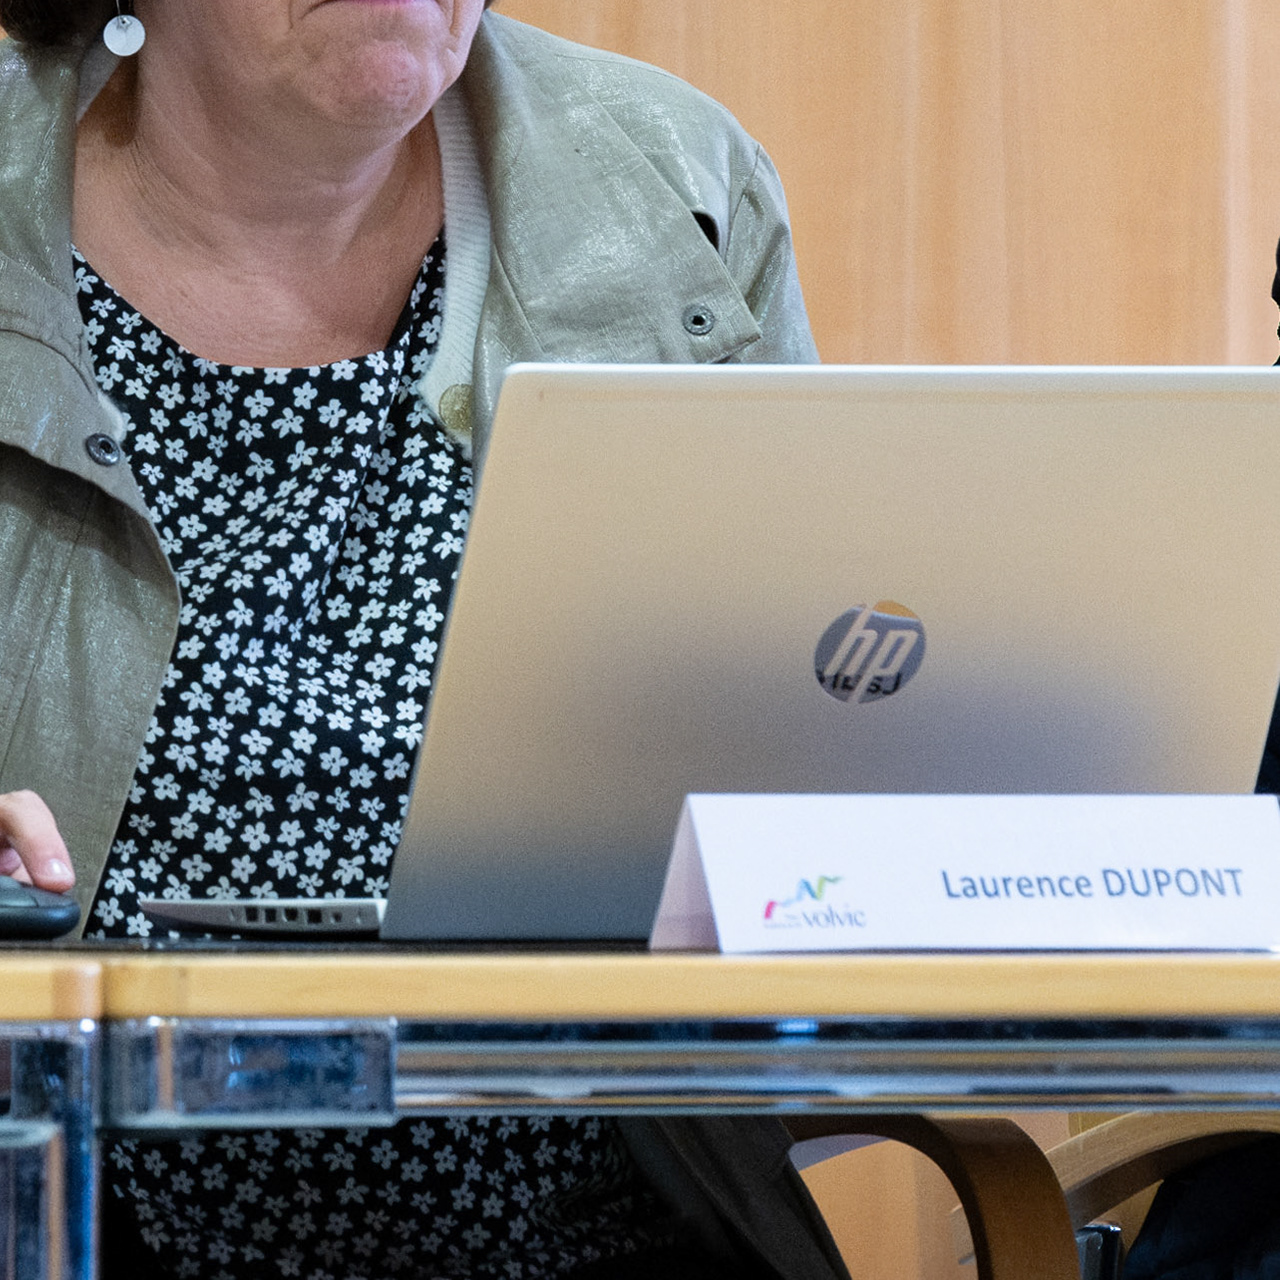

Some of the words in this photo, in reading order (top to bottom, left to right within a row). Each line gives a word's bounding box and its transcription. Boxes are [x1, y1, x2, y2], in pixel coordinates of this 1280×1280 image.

[822, 602, 920, 704] hp
[941, 869, 1094, 899] Laurence
[1101, 867, 1244, 898] DUPONT
